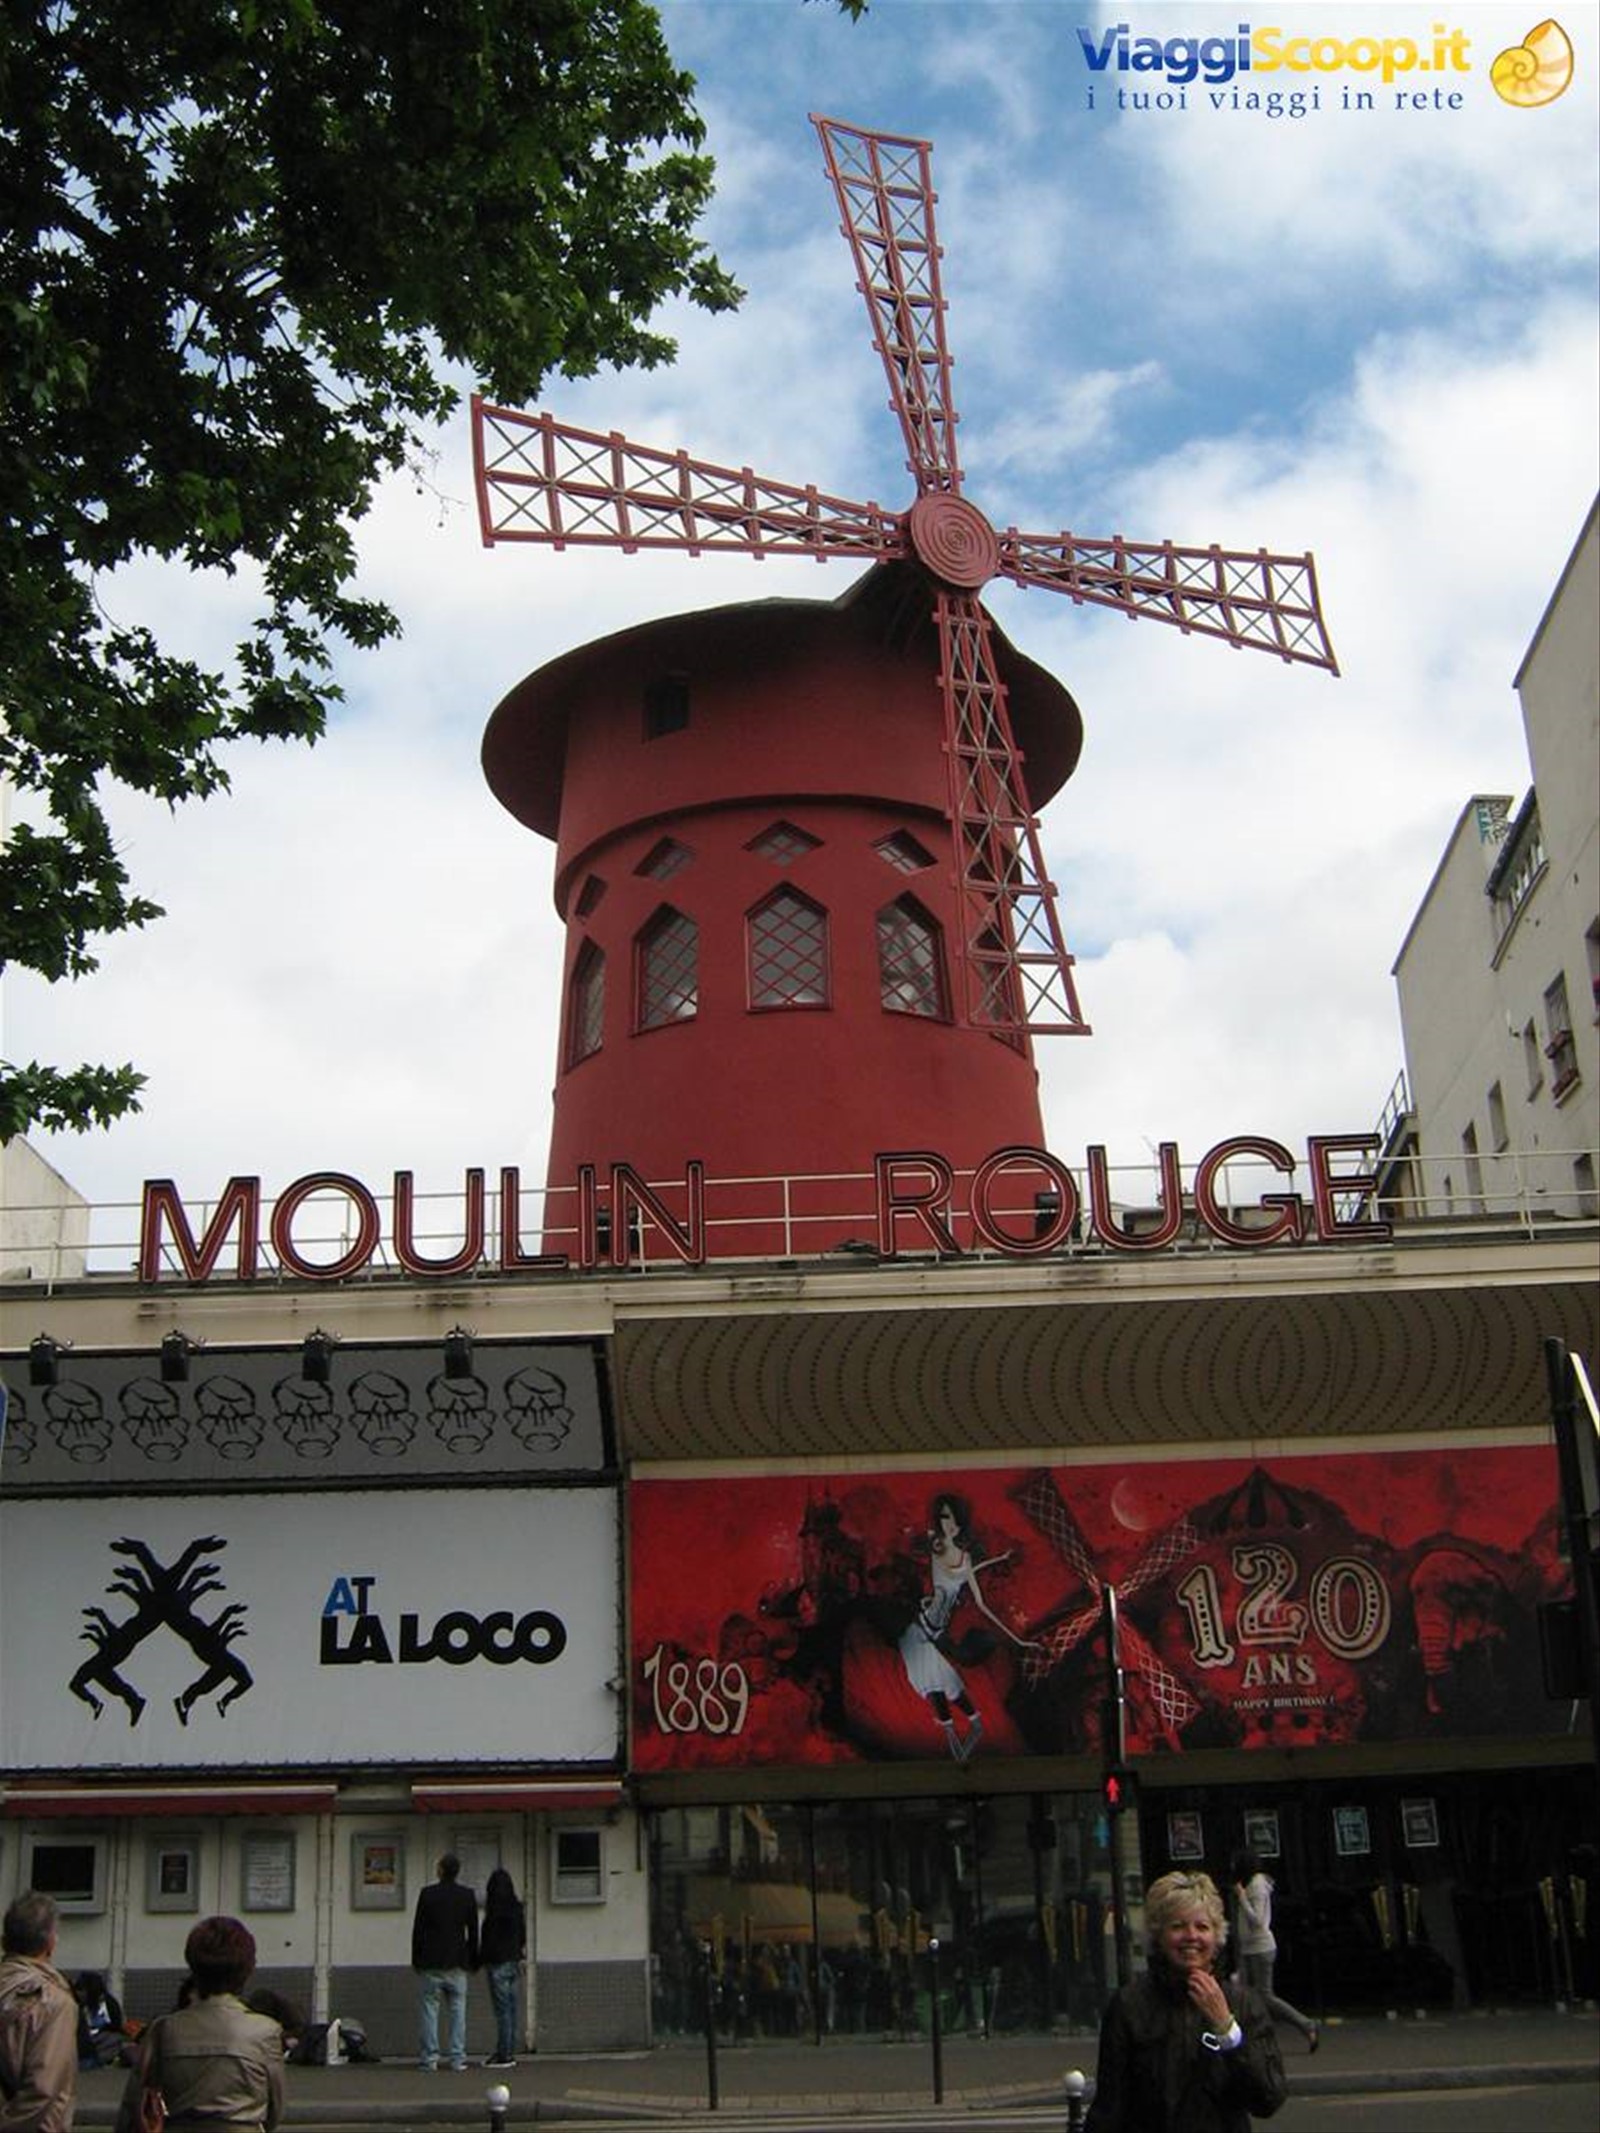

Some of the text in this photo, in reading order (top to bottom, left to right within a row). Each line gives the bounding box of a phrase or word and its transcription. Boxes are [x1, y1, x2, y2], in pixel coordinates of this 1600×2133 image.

[138, 1134, 1394, 1284] MOULIN ROUGE
[322, 1576, 376, 1615] AT
[1176, 1541, 1391, 1669] 120
[320, 1610, 567, 1665] LA LOCO
[1241, 1653, 1317, 1688] ANS
[644, 1645, 749, 1735] 1889
